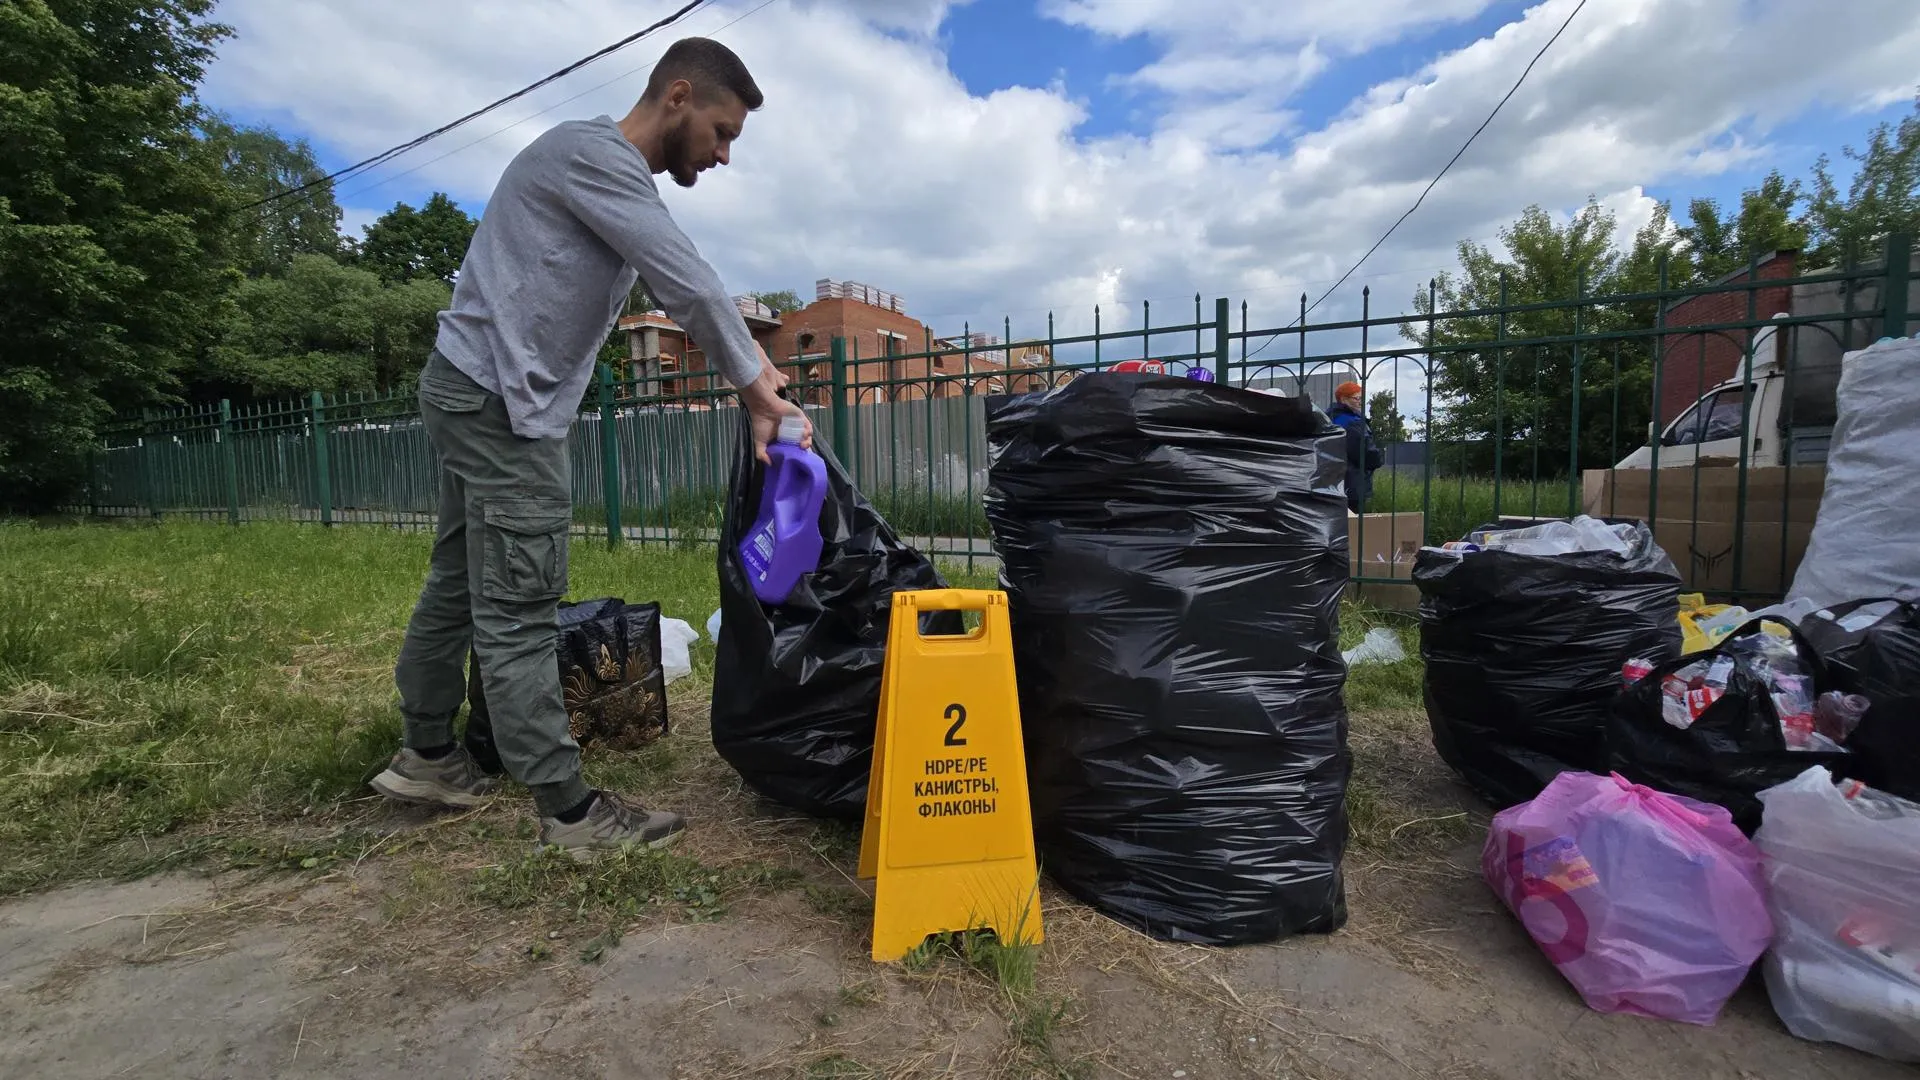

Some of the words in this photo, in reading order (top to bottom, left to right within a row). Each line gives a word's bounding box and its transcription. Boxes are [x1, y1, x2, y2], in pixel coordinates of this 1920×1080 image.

[944, 703, 967, 746] 2
[925, 757, 988, 775] HDPE/PE
[914, 777, 999, 797] КАНИСТРЫ,
[918, 798, 996, 818] ФЛАКОНЫ
